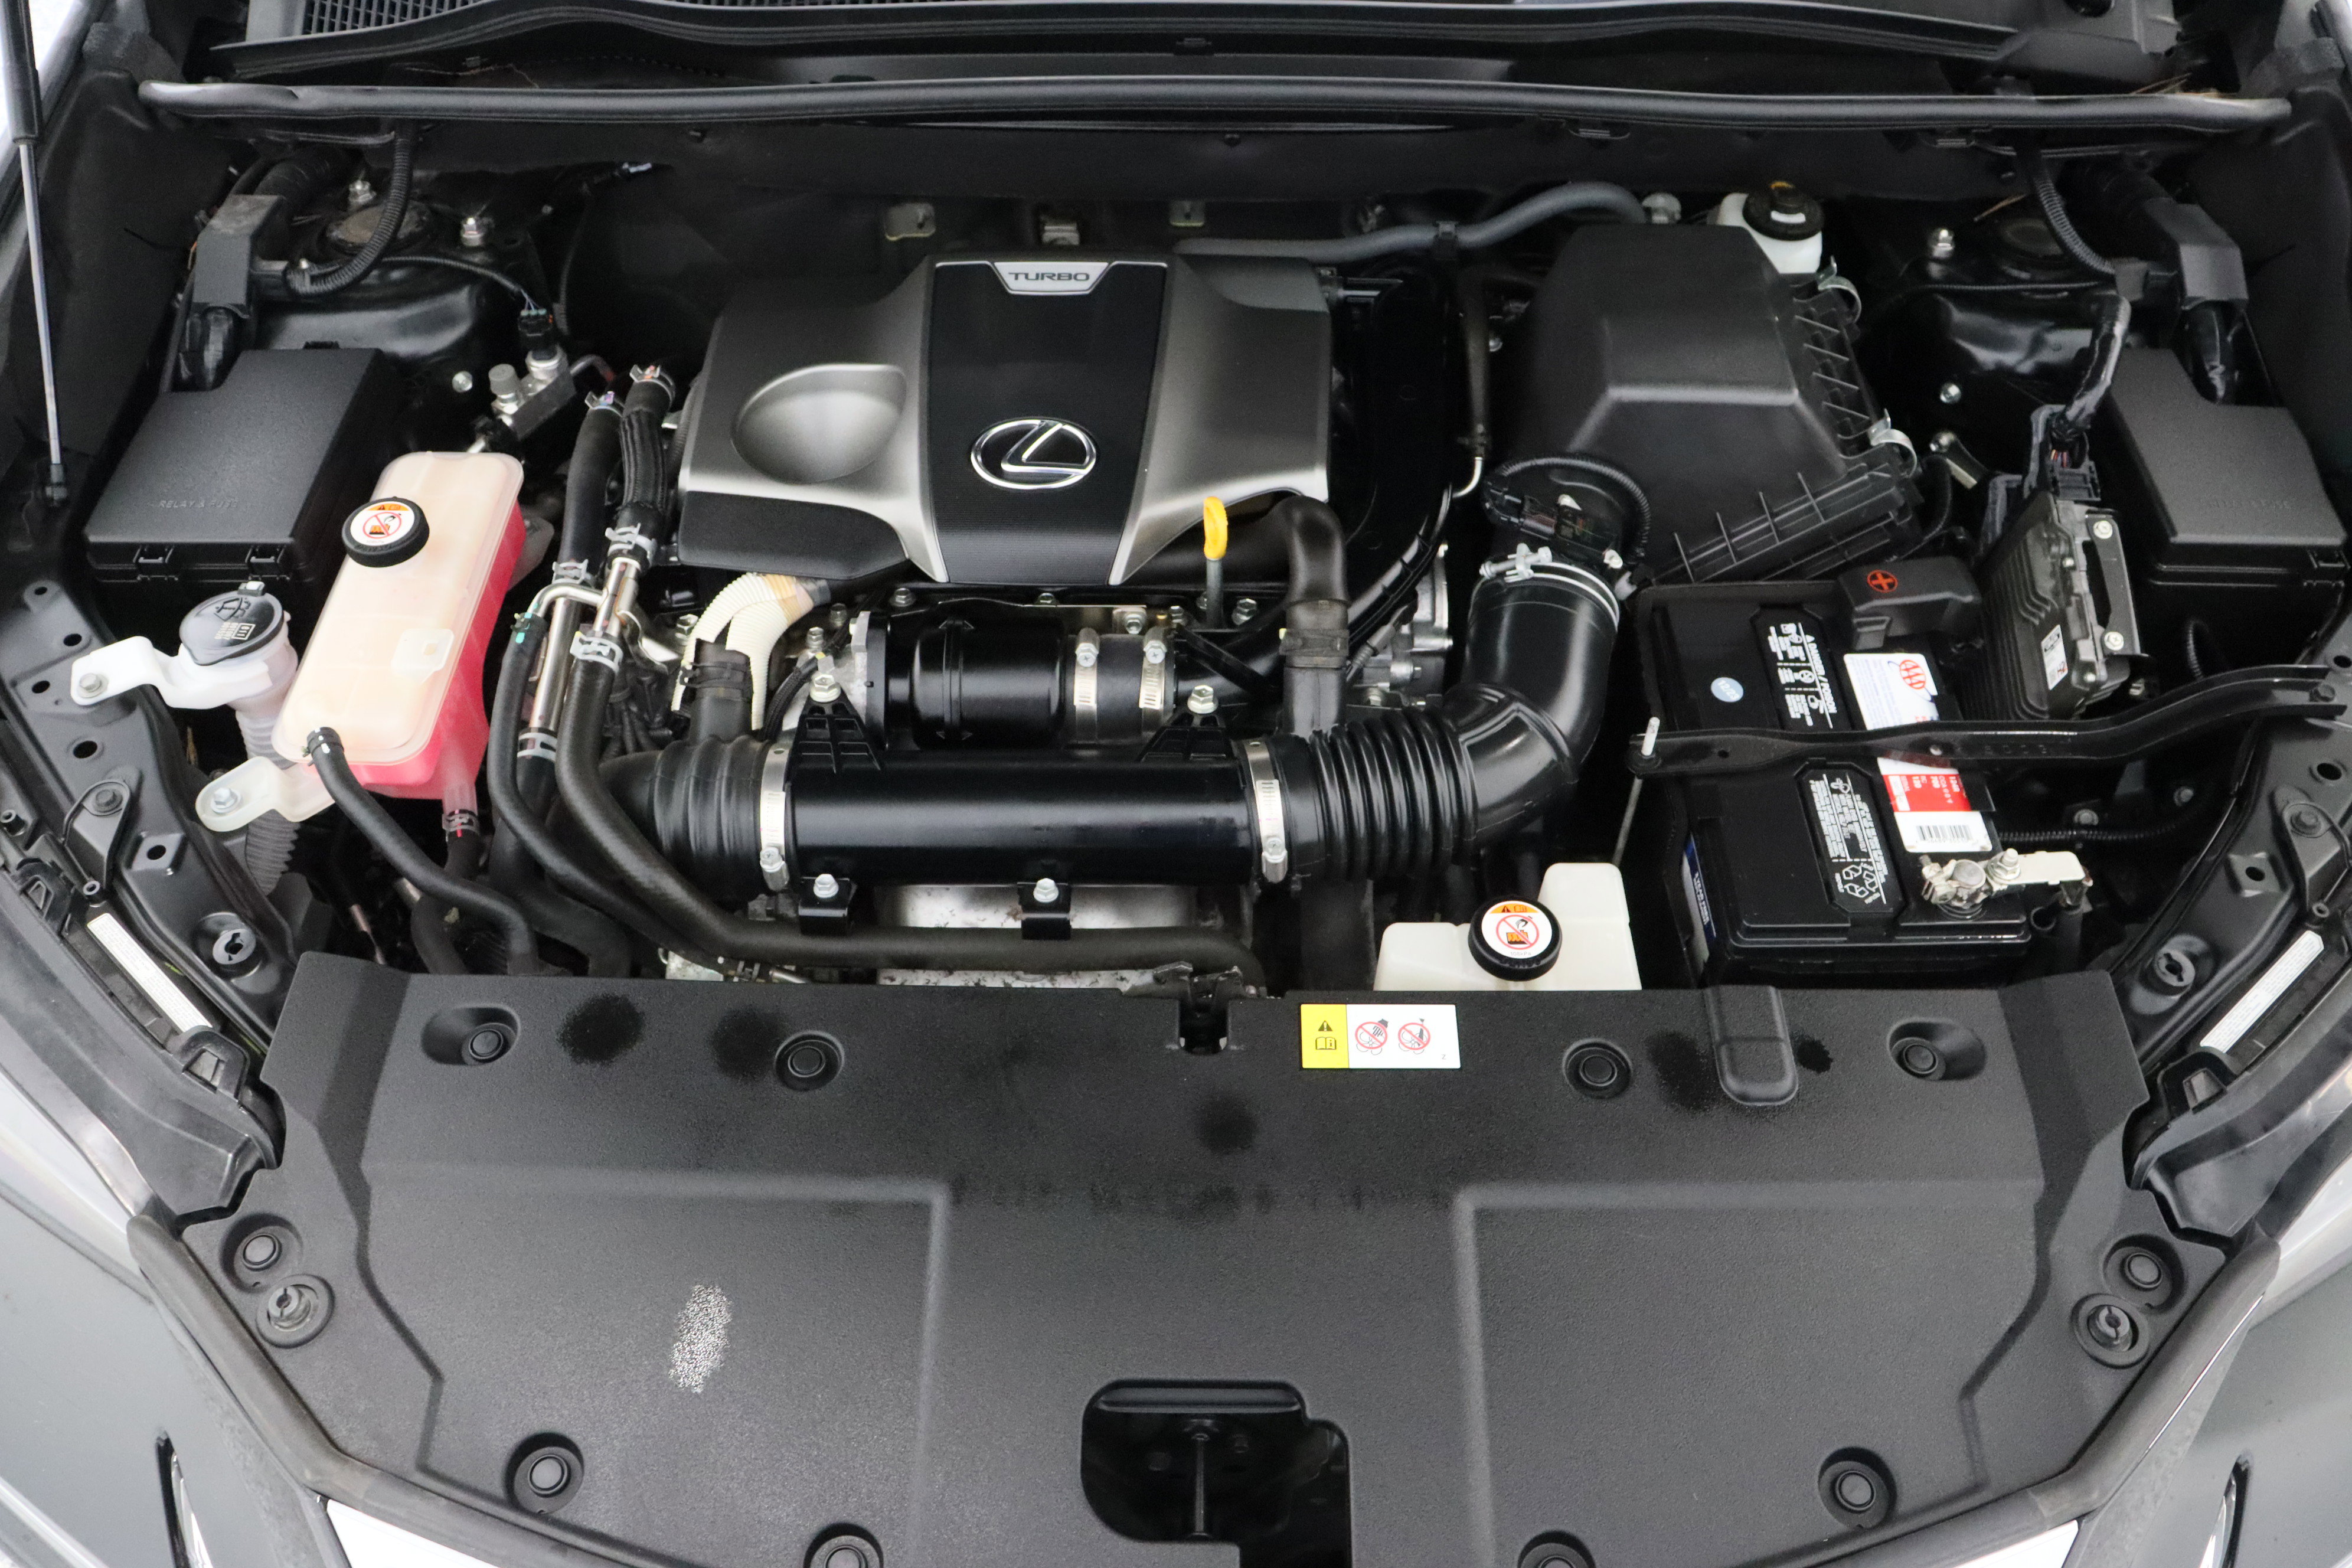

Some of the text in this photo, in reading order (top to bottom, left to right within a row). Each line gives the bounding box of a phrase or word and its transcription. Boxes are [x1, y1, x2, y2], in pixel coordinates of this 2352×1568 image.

[1008, 272, 1090, 282] TURBO
[159, 499, 195, 508] RELAY
[1808, 642, 1825, 676] DANGER
[1820, 682, 1838, 714] POISON
